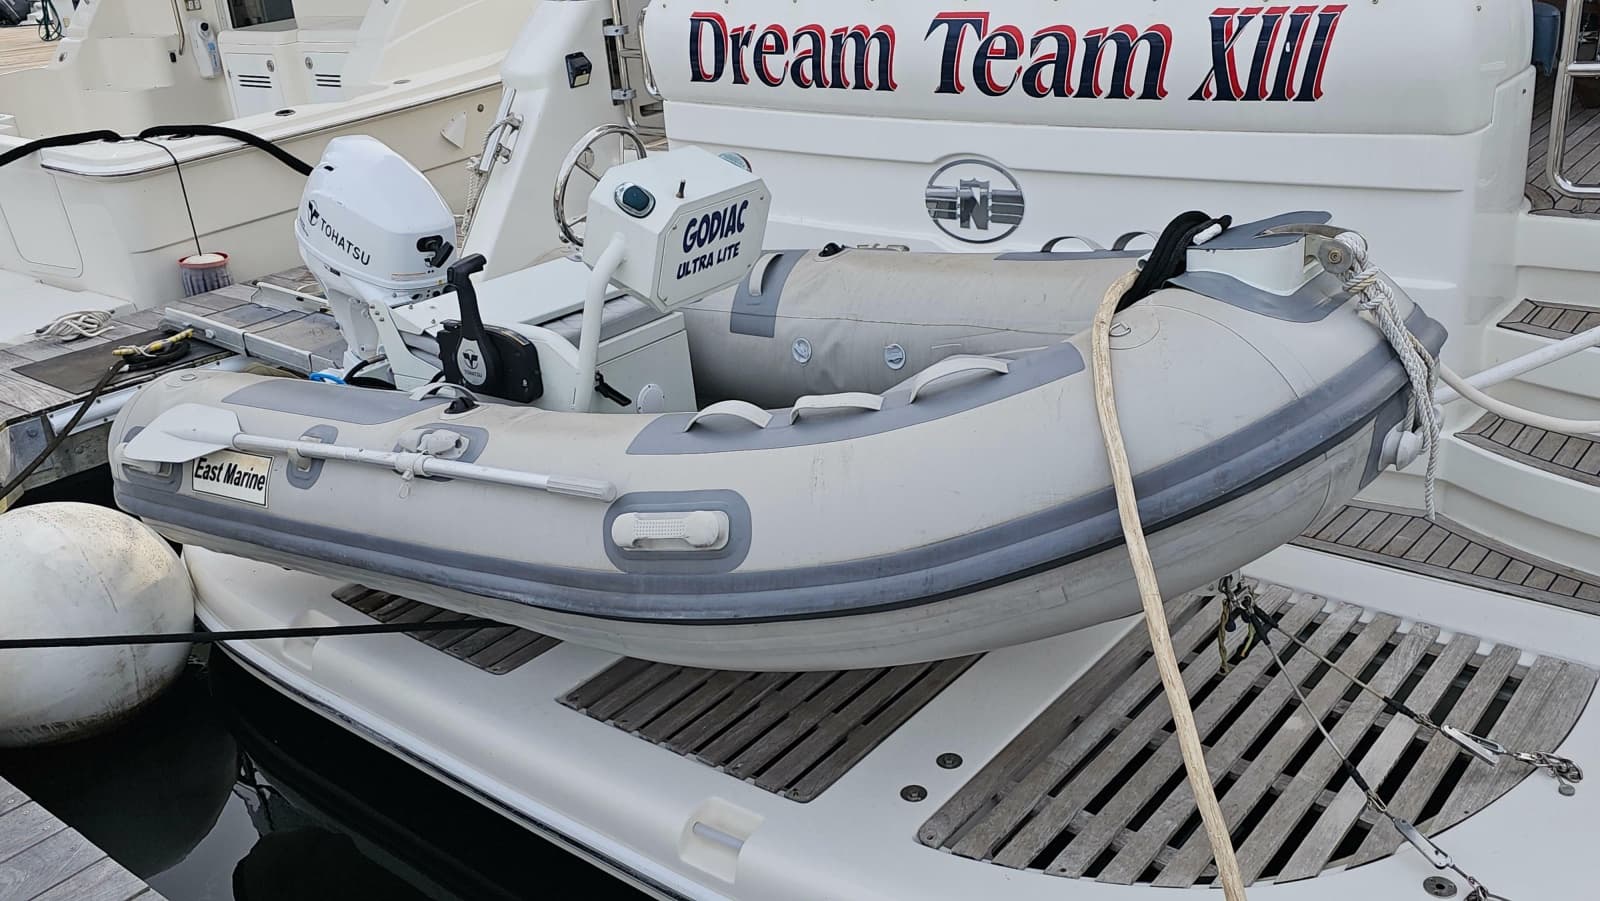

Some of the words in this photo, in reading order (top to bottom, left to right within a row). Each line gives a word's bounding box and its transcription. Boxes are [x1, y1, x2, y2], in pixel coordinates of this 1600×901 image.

[689, 11, 898, 92] Dream
[923, 11, 1173, 100] Team
[1187, 4, 1349, 102] XIII
[320, 217, 371, 266] TOHATSU
[682, 199, 749, 254] GODIAC
[676, 251, 714, 280] ULTRA
[716, 241, 741, 264] LITE
[194, 457, 225, 483] East
[223, 462, 266, 491] Marine
